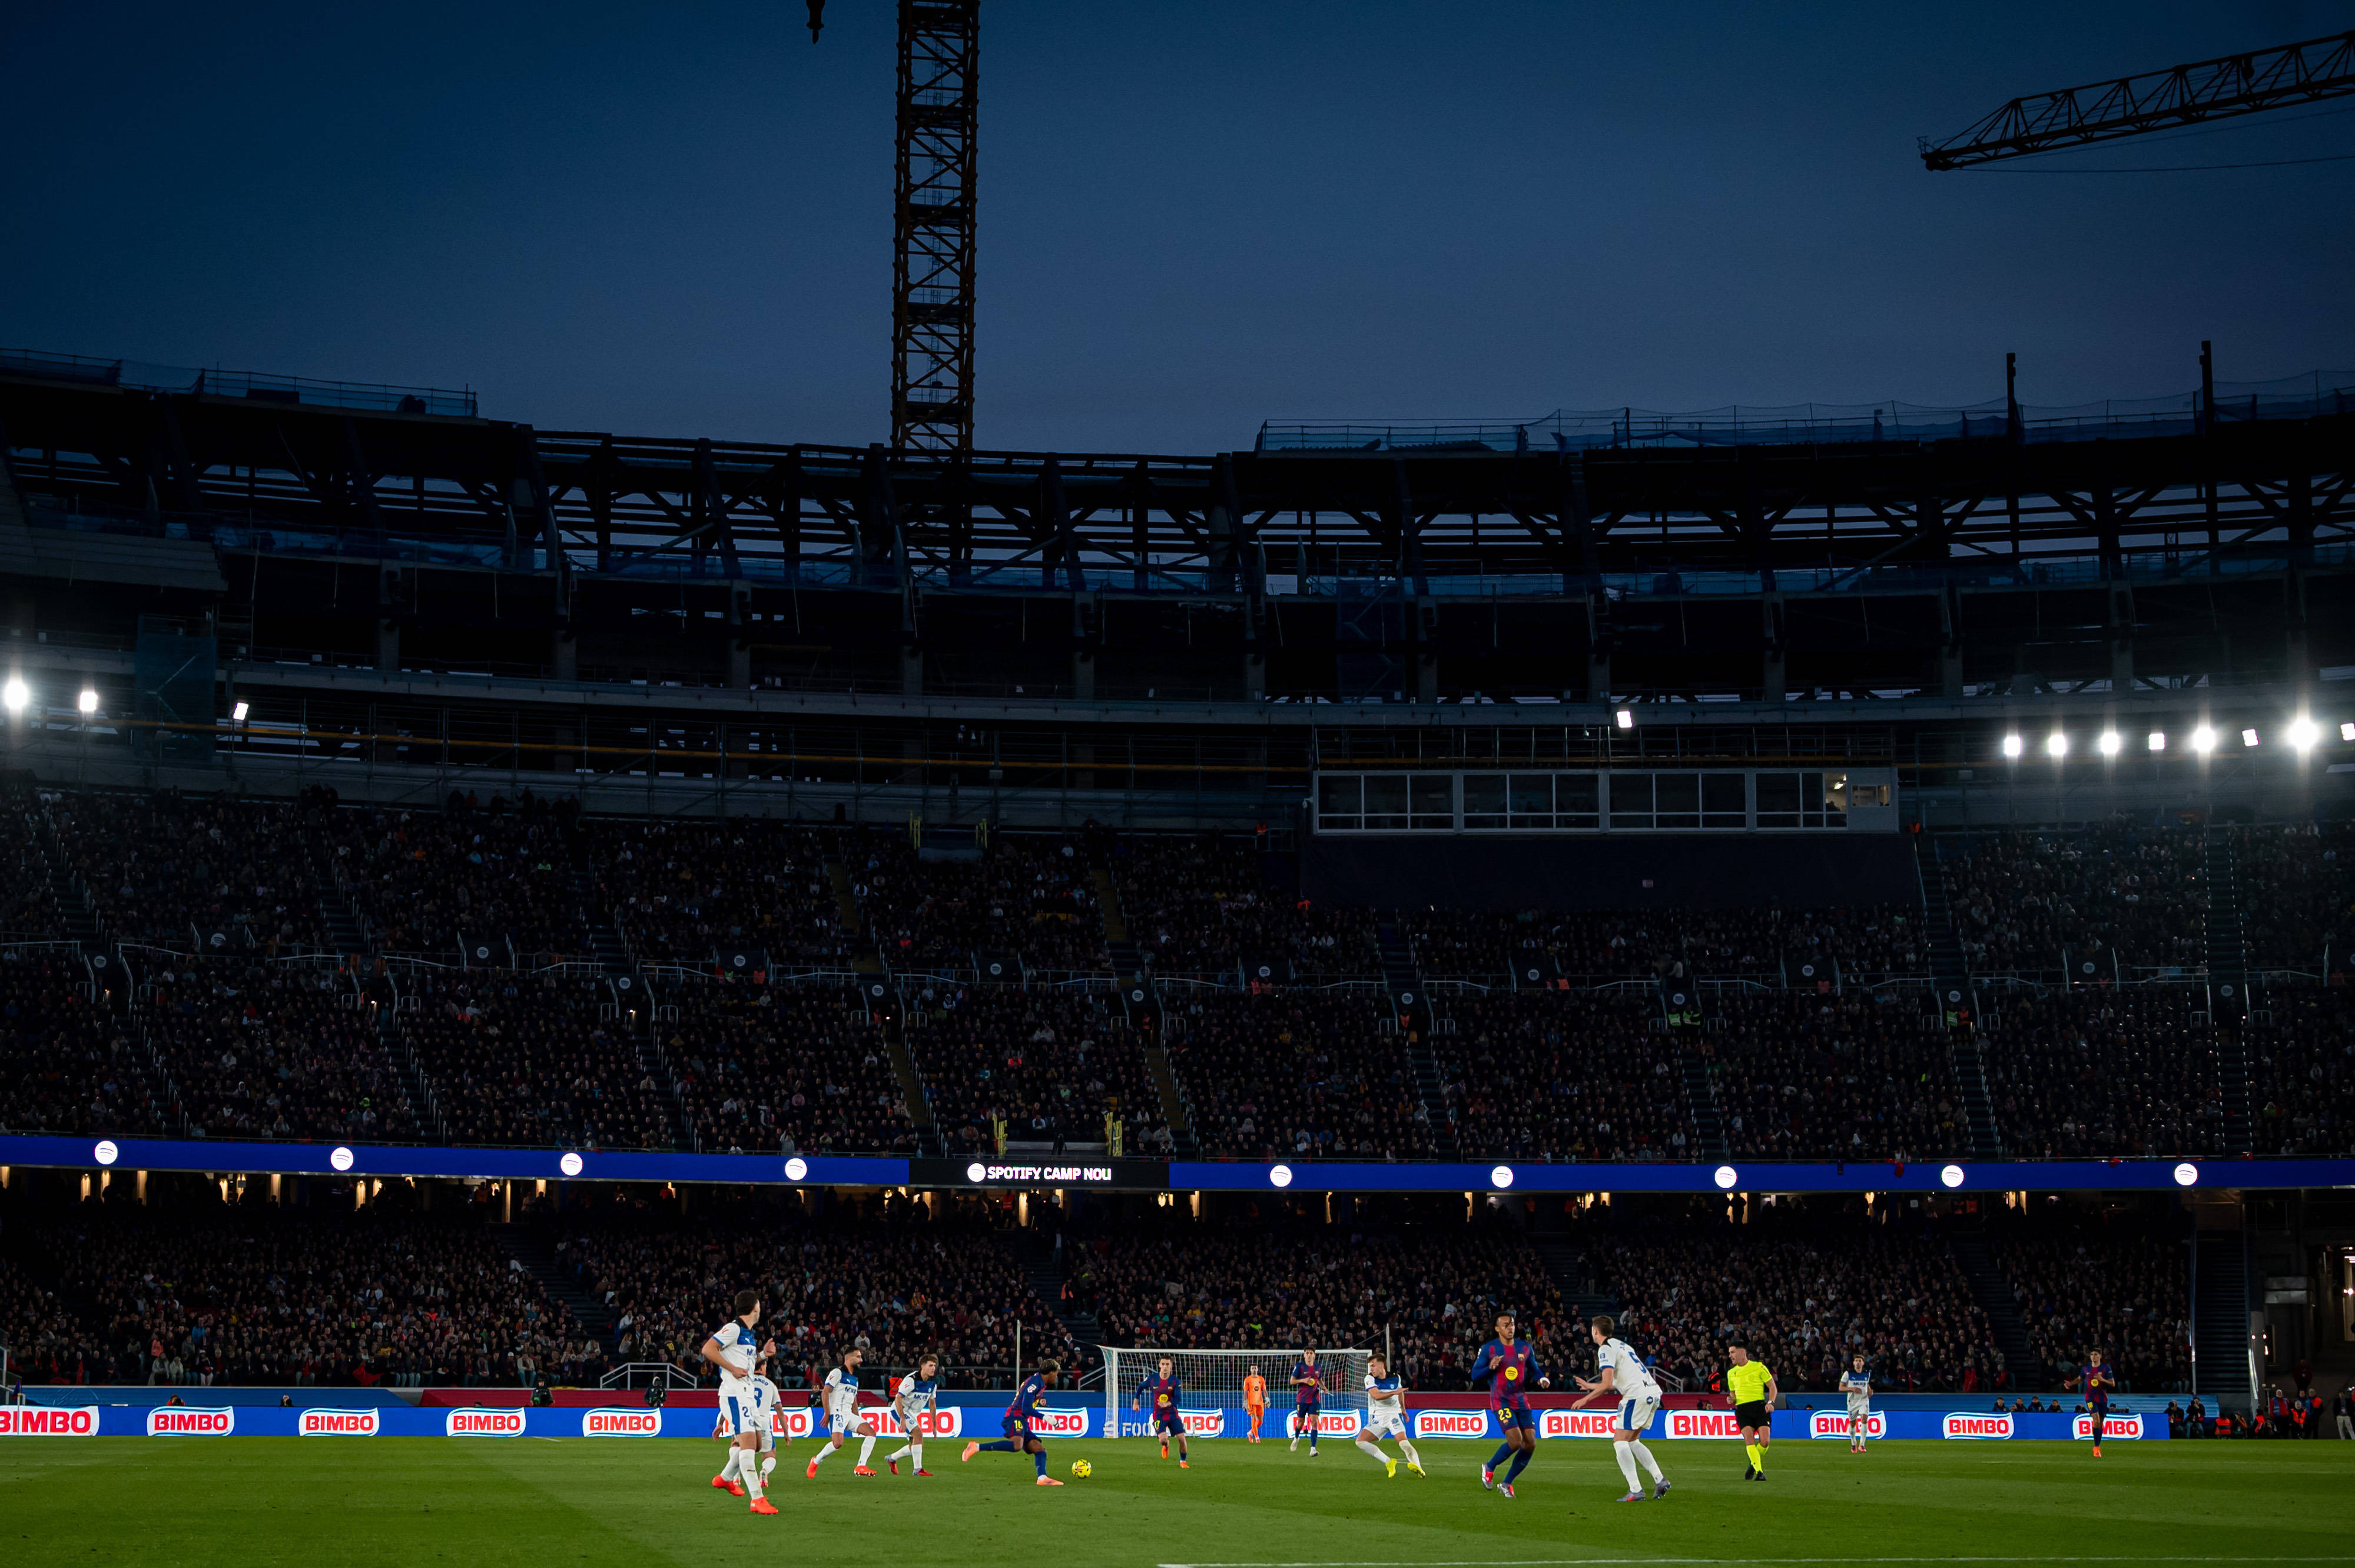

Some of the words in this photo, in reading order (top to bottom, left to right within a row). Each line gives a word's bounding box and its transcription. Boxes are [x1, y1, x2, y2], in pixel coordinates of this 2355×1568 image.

[987, 1166, 1041, 1180] SPOTIFY
[1043, 1167, 1082, 1181] CAMP
[1083, 1167, 1112, 1181] NOU
[0, 1411, 91, 1433] BIMBO
[1498, 1407, 1512, 1421] 23
[154, 1414, 228, 1431] BIMBO
[306, 1416, 374, 1431] BIMBO
[453, 1415, 520, 1431] BIMBO
[589, 1415, 656, 1431] BIMBO
[1027, 1415, 1082, 1431] IMBO
[1421, 1417, 1482, 1432] BIMBO
[1673, 1415, 1742, 1436] BIMB
[1949, 1419, 2009, 1434] BIMBO
